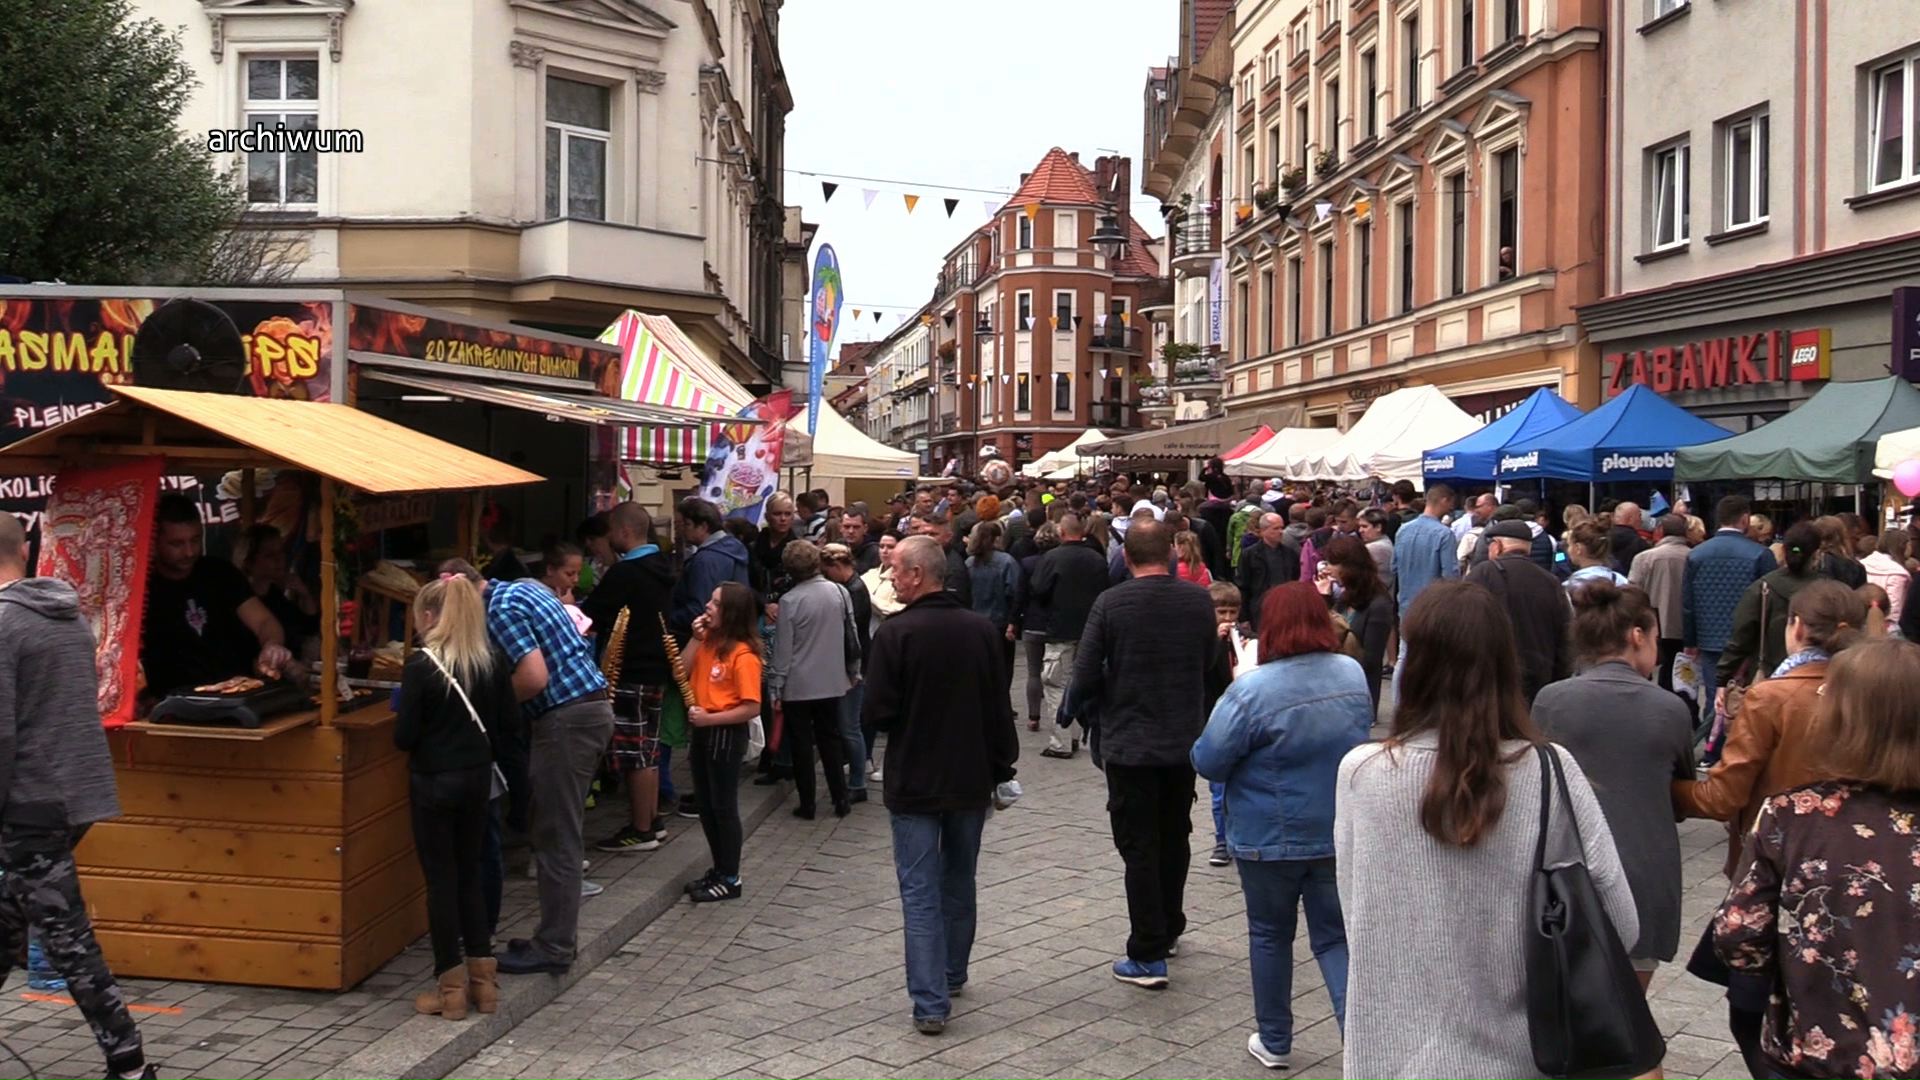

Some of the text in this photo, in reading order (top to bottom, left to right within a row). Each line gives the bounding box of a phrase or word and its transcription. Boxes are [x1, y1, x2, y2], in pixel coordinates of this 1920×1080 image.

[425, 340, 445, 361] 20
[1791, 346, 1817, 365] LEGO
[1605, 330, 1783, 398] ZABAWKI
[1501, 452, 1539, 473] playmobil
[1602, 452, 1676, 473] playmob
